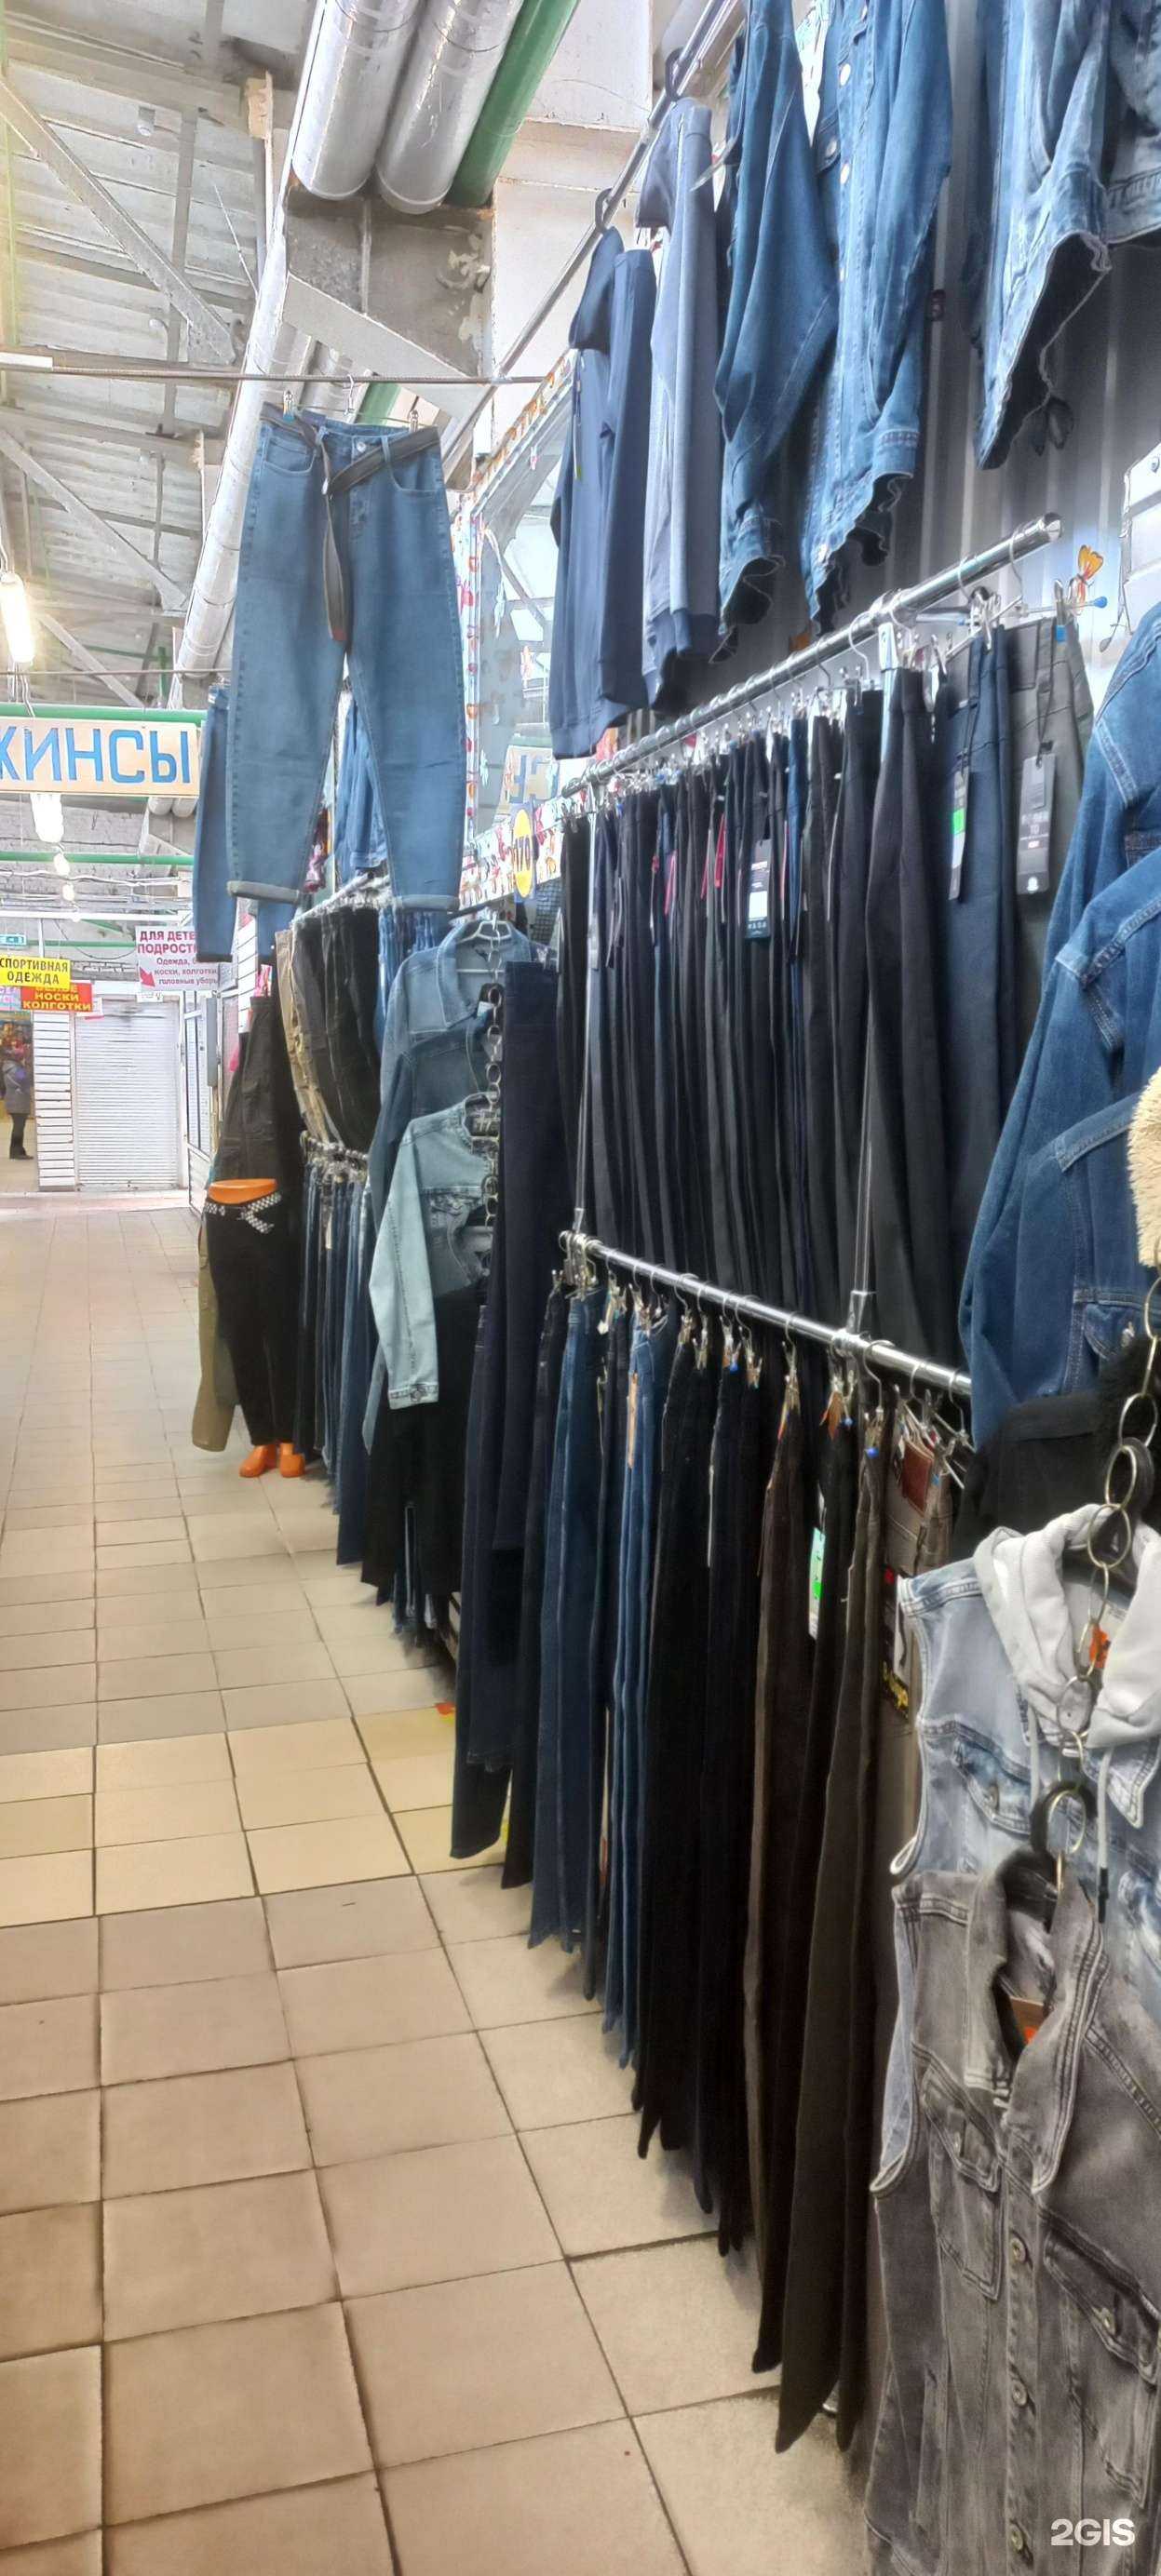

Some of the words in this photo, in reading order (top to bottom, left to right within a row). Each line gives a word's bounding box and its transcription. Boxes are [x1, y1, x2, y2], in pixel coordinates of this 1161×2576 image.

[140, 931, 164, 942] ДЛЯ
[168, 931, 196, 942] ДЕТЕ
[138, 943, 197, 955] ПОДРОСТ
[0, 958, 68, 973] СПОРТИВНАЯ
[7, 971, 60, 986] ОДЕЖДА
[34, 992, 79, 1002] НОСКИ
[22, 1000, 91, 1012] КОЛГОТКИ
